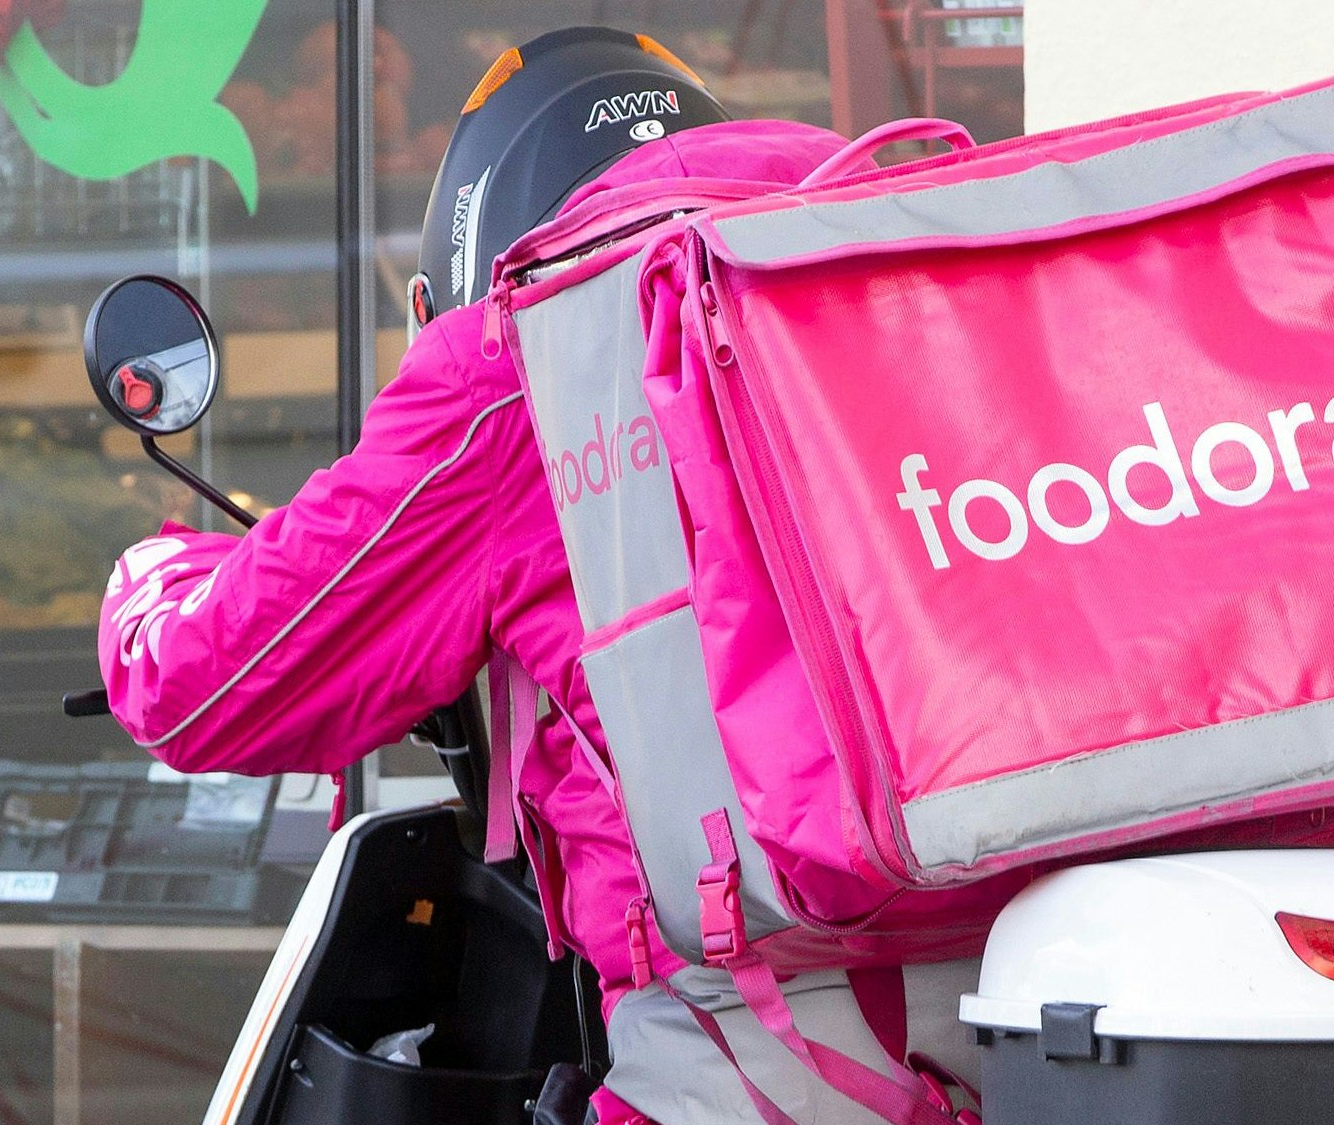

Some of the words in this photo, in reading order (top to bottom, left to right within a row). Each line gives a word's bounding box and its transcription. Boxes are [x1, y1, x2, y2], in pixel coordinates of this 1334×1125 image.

[584, 90, 681, 133] AWN
[632, 122, 660, 139] CE
[452, 183, 474, 248] AWN
